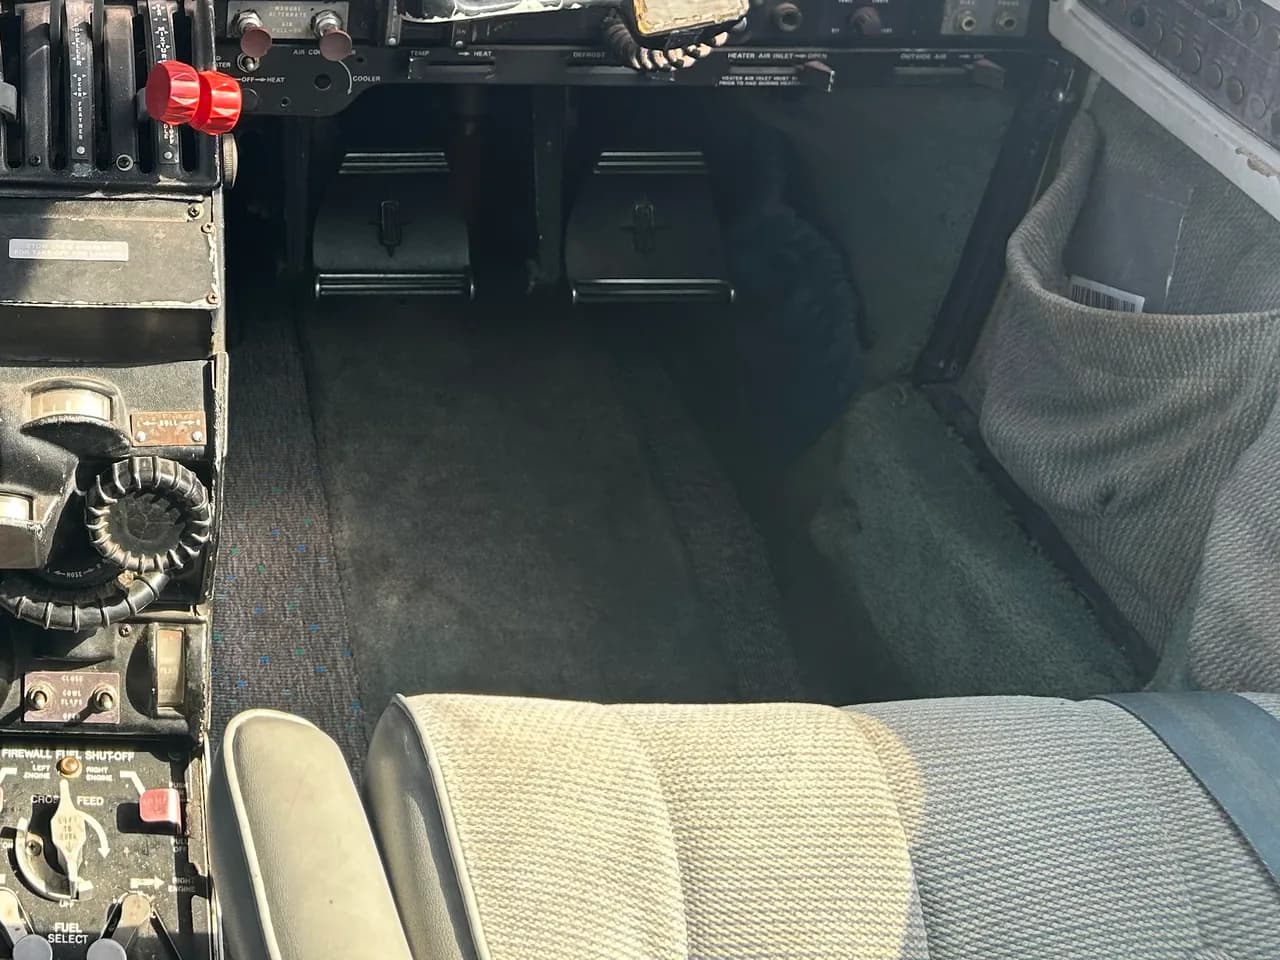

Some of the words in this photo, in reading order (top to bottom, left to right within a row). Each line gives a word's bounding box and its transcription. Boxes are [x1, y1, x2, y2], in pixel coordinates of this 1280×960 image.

[1, 748, 52, 759] FIREWALL
[84, 751, 134, 762] SHUT-OFF
[76, 796, 104, 806] FEED
[54, 922, 82, 932] FUEL
[48, 934, 89, 946] SELECT
